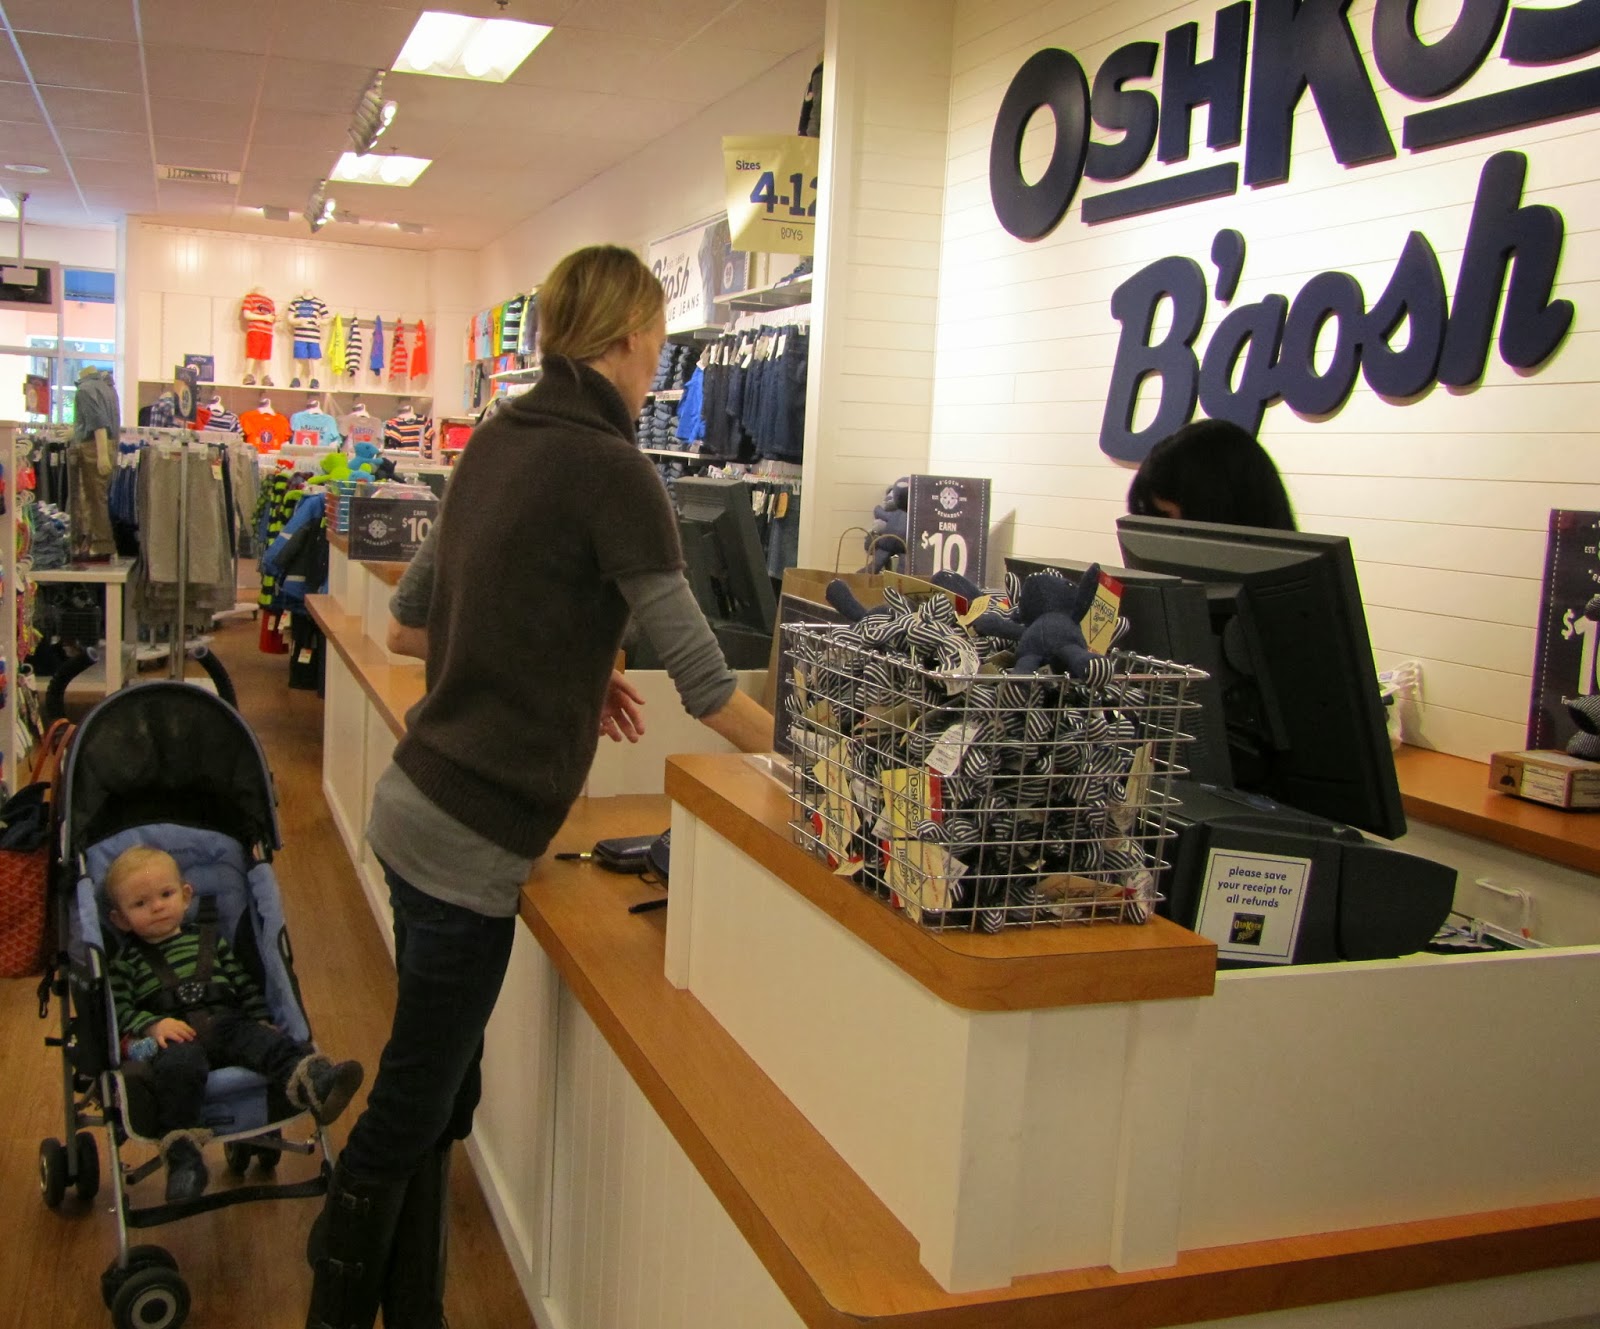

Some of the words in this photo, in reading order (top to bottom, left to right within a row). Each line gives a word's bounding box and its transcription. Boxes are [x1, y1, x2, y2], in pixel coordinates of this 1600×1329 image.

[735, 160, 761, 170] Sizes
[781, 227, 803, 241] BOYS
[679, 293, 700, 317] JEANS
[402, 517, 433, 542] $10
[938, 521, 957, 532] EARN
[921, 530, 968, 577] $10
[1228, 866, 1262, 878] please
[1264, 871, 1287, 881] save
[1217, 881, 1240, 891] your
[1242, 883, 1277, 896] receipt
[1278, 885, 1293, 896] for
[1226, 894, 1240, 904] all
[1241, 895, 1279, 908] refunds
